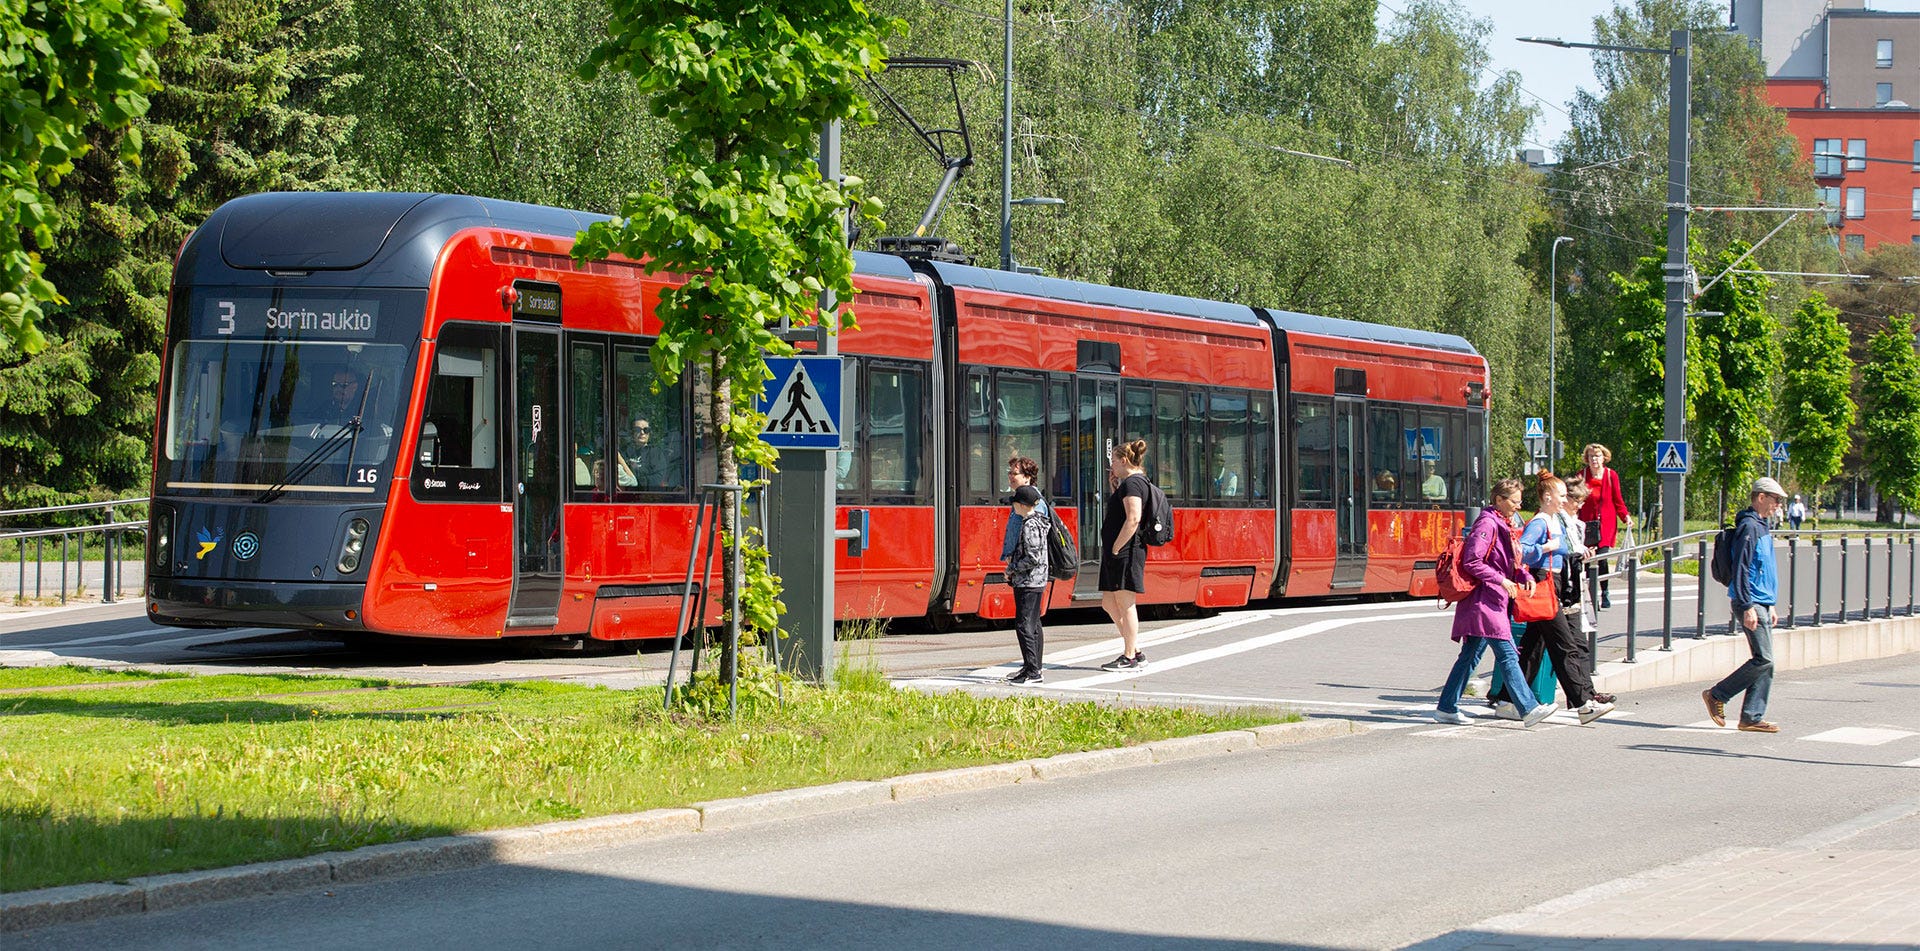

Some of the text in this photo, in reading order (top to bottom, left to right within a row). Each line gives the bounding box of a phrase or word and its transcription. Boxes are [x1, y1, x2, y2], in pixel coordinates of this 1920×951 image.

[218, 301, 371, 335] 3 Sorin aukio
[356, 468, 378, 484] 16
